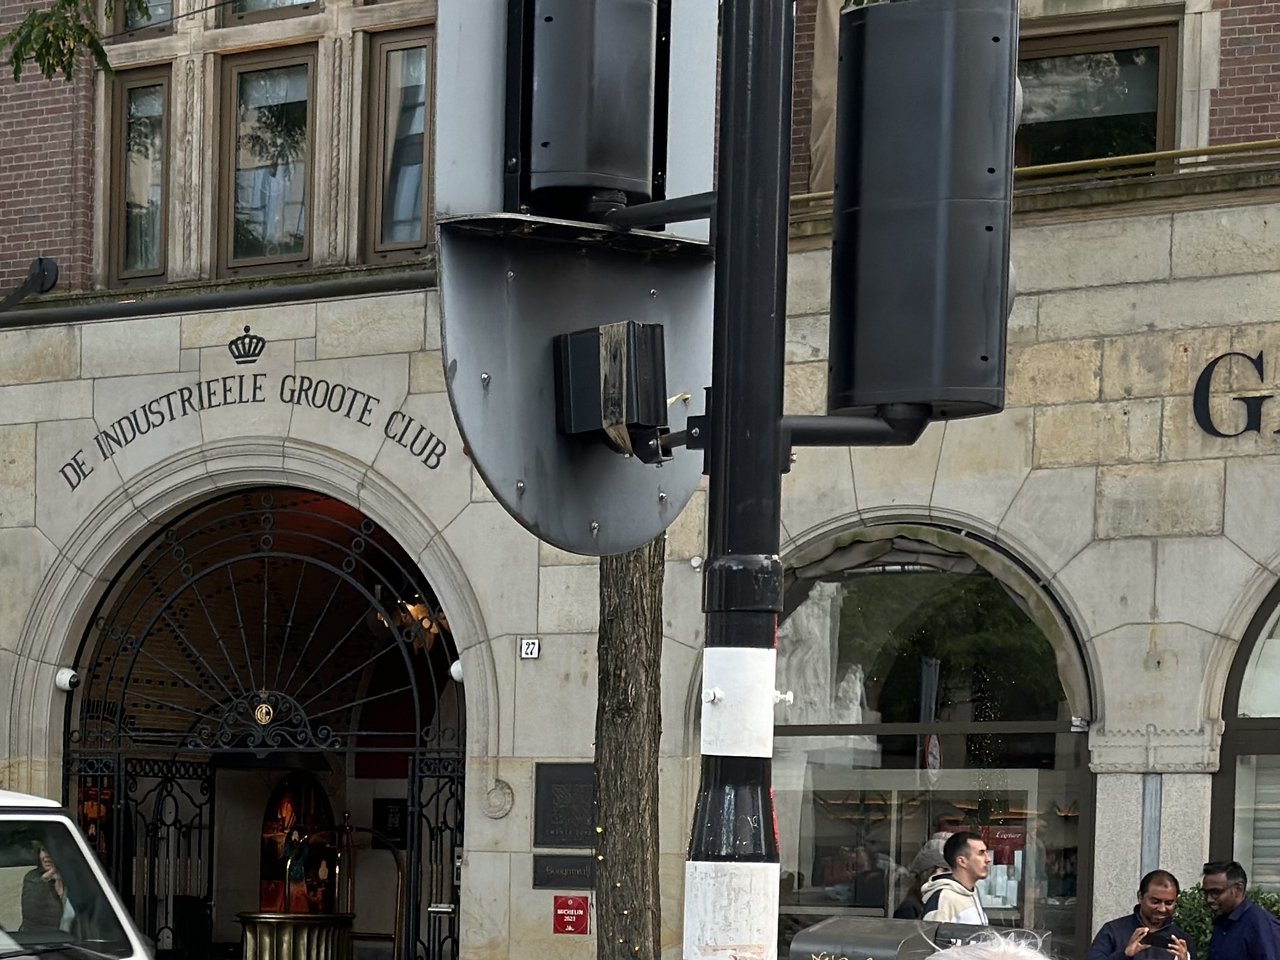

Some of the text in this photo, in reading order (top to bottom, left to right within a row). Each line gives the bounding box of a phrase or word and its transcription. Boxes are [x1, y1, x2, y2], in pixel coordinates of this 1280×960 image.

[59, 373, 447, 492] DE INDUSTRIEELE GROOTE CLUB
[1193, 350, 1280, 438] G
[524, 641, 536, 656] 27
